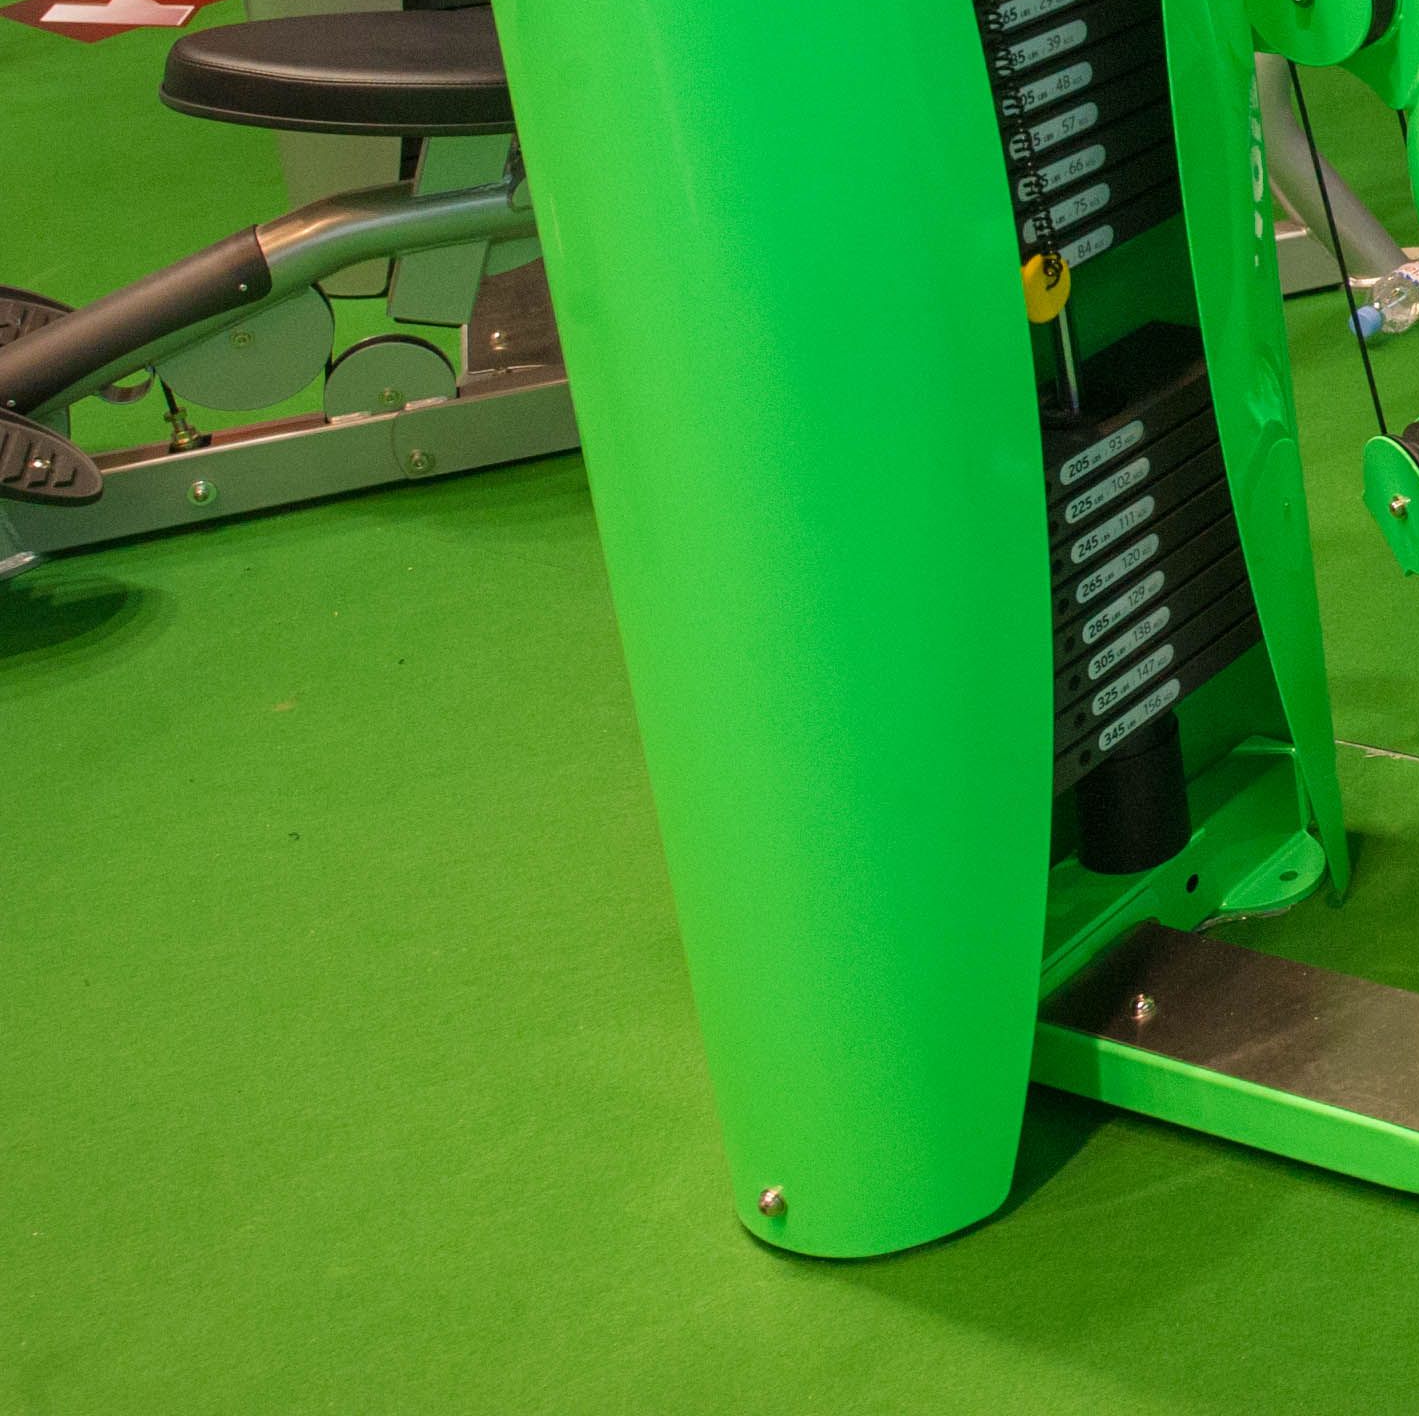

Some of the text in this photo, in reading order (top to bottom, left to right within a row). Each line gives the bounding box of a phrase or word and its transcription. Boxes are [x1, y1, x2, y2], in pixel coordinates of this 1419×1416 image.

[1002, 7, 1018, 24] 65
[1046, 35, 1061, 49] 39
[1021, 90, 1035, 106] 05
[1056, 75, 1070, 91] 48
[1062, 116, 1076, 134] 57
[1069, 158, 1084, 175] 66
[1073, 198, 1089, 214] 75
[1077, 240, 1092, 259] 84
[1068, 456, 1090, 478] 205
[1108, 436, 1123, 452] 93
[1071, 496, 1094, 518] 225
[1111, 472, 1131, 493] 102
[1078, 535, 1099, 558] 245
[1119, 511, 1136, 530] 111
[1082, 574, 1103, 597] 265
[1121, 547, 1141, 569] 120
[1088, 614, 1110, 639] 285
[1127, 585, 1145, 608] 129
[1093, 650, 1116, 674] 305
[1133, 621, 1152, 643] 138
[1096, 686, 1119, 710] 325
[1136, 659, 1155, 681] 147
[1103, 722, 1126, 746] 345
[1143, 696, 1162, 716] 156
